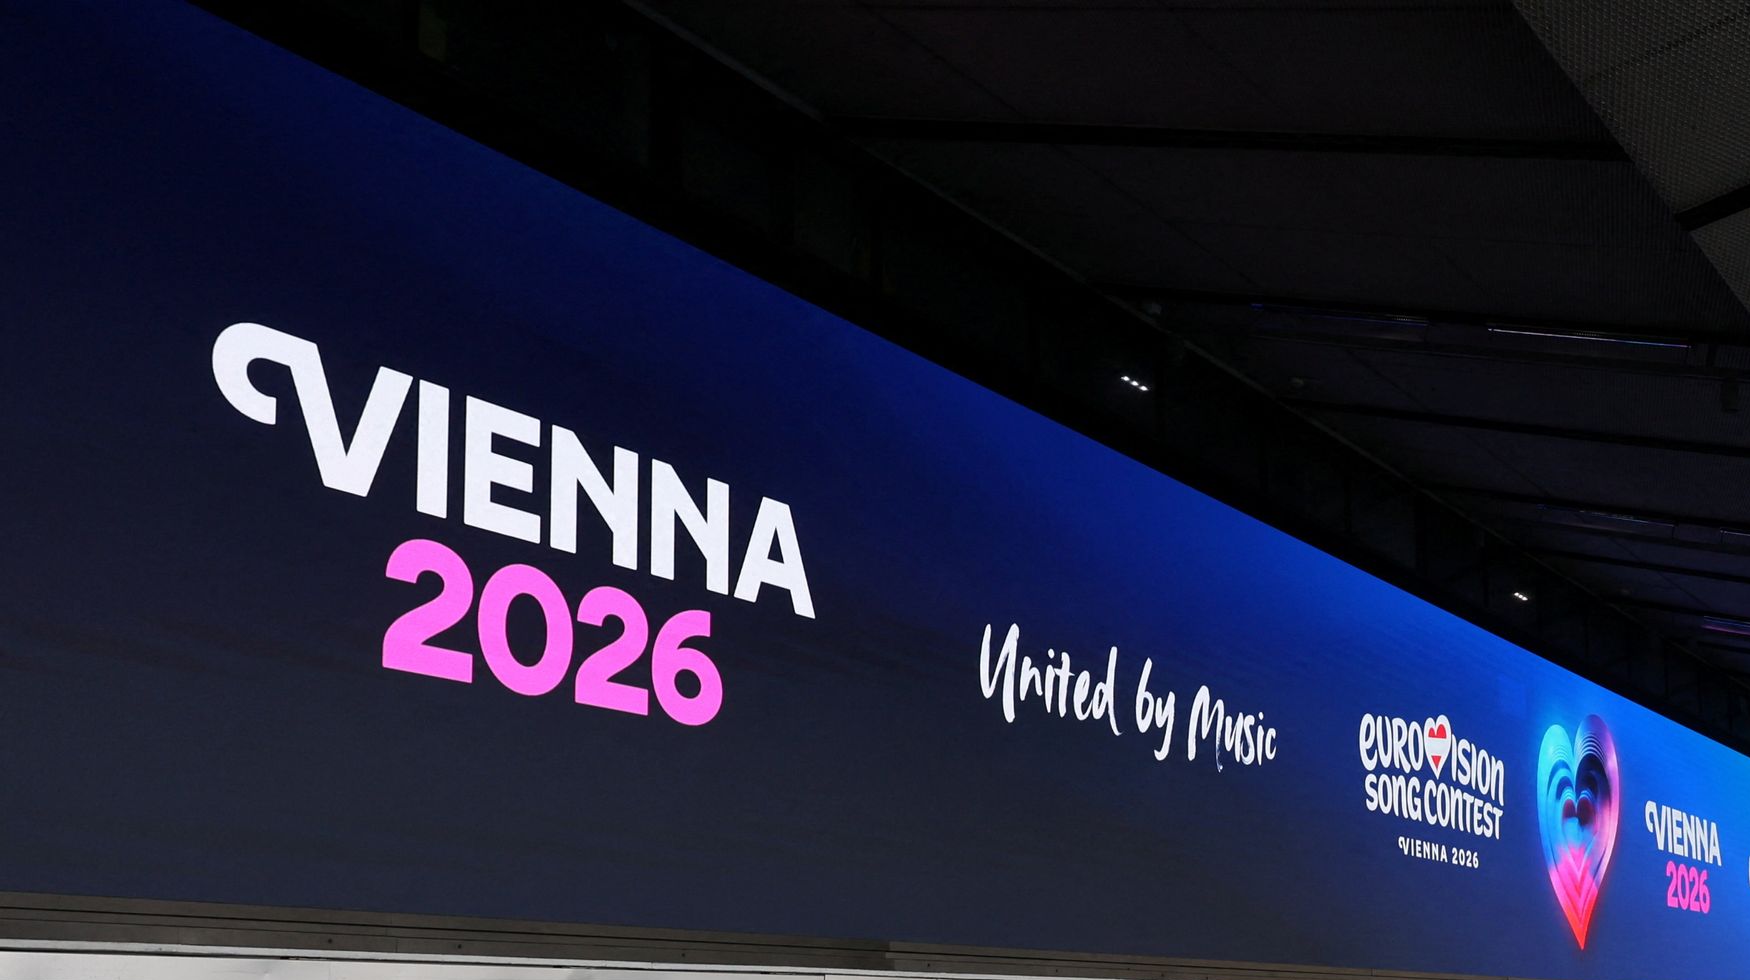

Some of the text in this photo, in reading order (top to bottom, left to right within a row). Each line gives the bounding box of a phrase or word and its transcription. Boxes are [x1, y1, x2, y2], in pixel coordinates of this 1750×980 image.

[211, 322, 816, 620] VIENNA
[382, 539, 723, 726] 2026
[979, 622, 1277, 774] United by Music
[1398, 836, 1479, 869] VIENNA 2026
[1644, 800, 1722, 867] VIENNA
[1666, 861, 1711, 914] 2026
